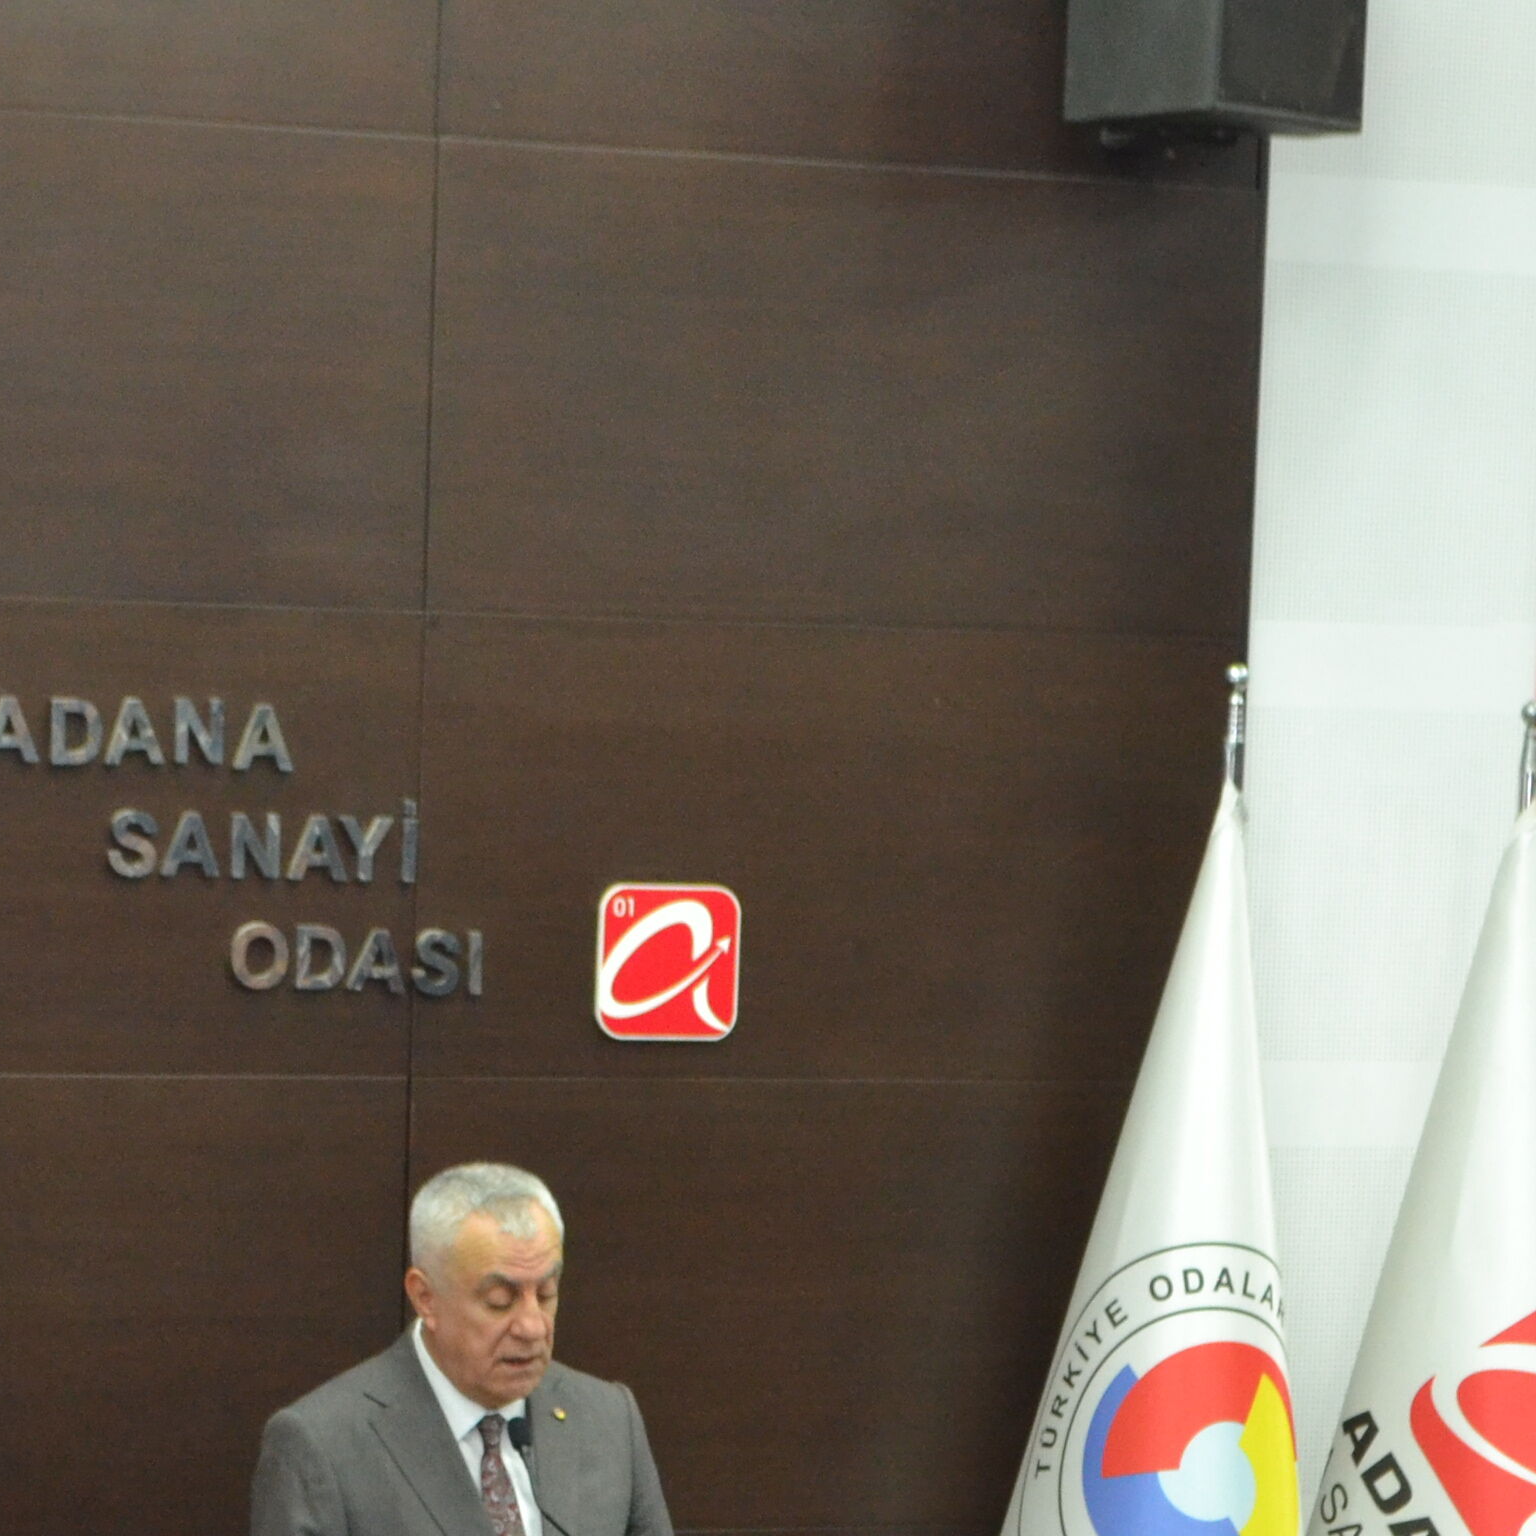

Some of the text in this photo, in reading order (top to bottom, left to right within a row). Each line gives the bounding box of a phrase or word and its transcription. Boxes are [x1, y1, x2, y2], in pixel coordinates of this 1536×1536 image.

[106, 799, 419, 884] SANAYİ
[612, 896, 636, 919] 01
[229, 920, 483, 996] ODASI
